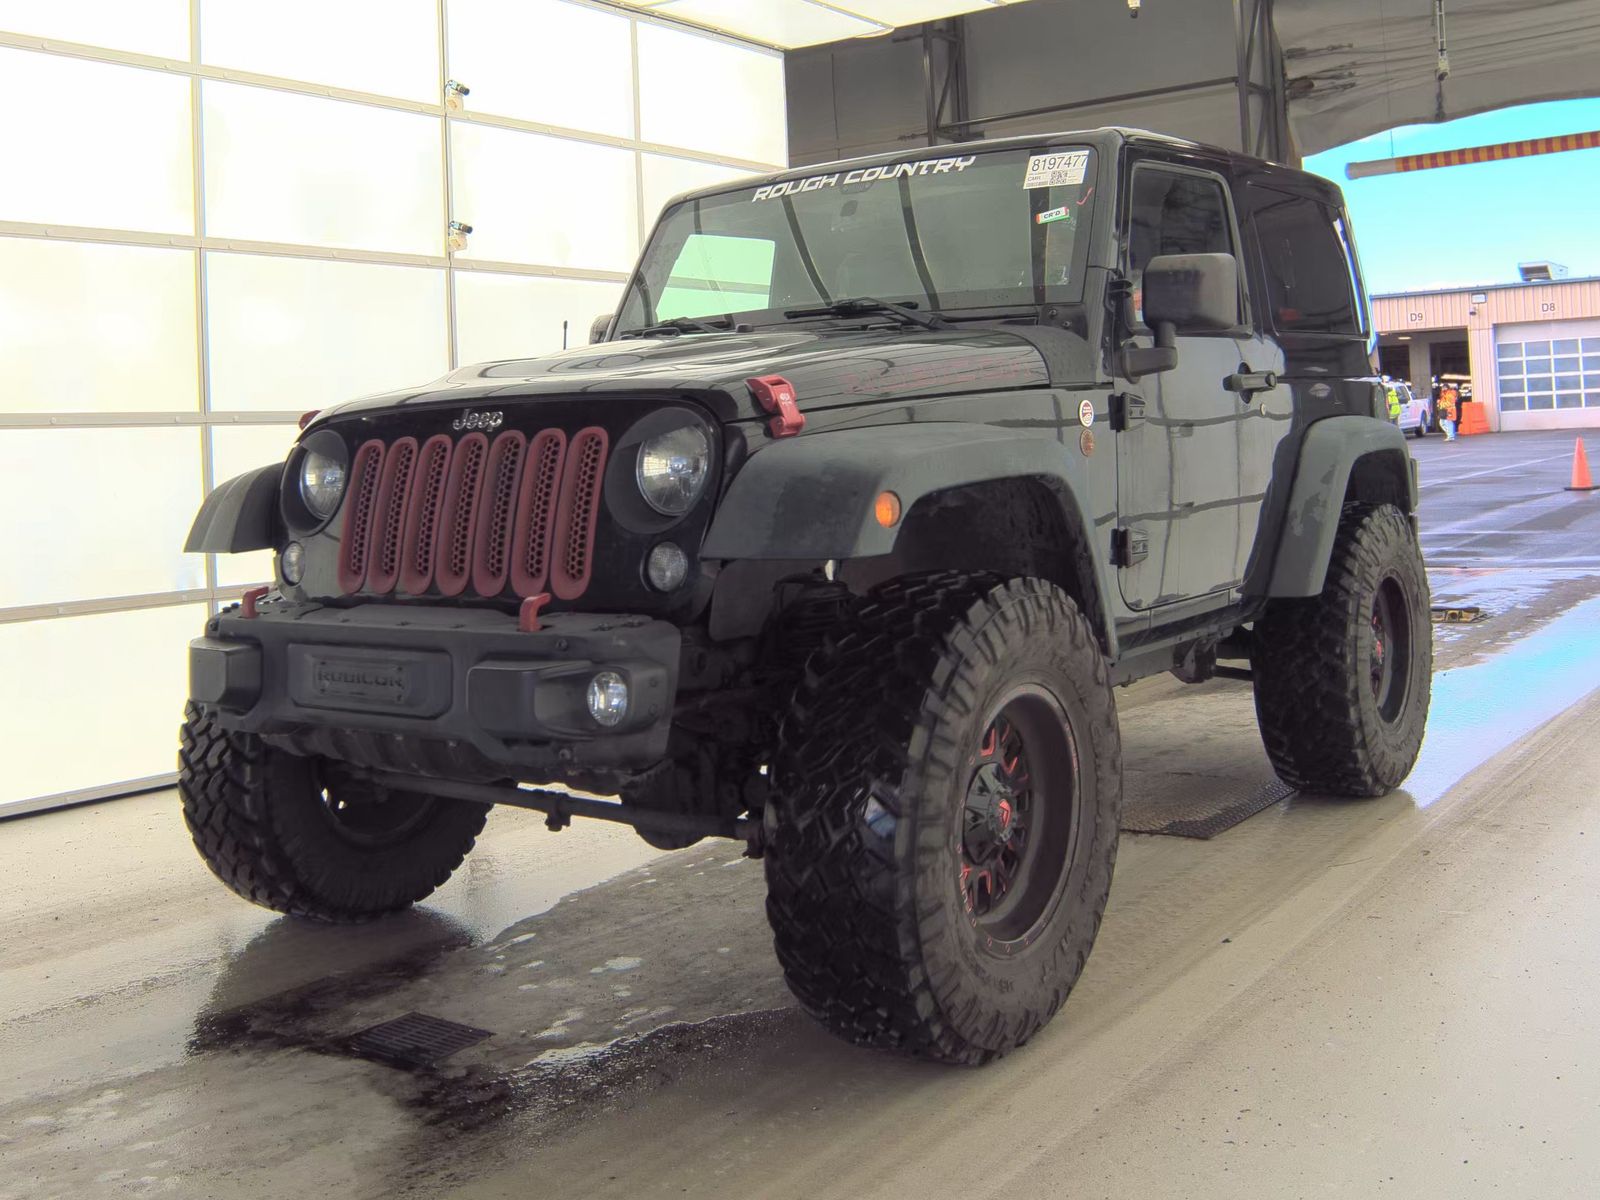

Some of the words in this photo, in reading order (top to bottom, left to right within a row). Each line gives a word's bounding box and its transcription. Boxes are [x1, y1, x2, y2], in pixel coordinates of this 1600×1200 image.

[1031, 154, 1088, 172] 8197477
[752, 174, 839, 202] ROUGH
[843, 156, 976, 185] COUNTRY
[1541, 302, 1556, 313] D8
[1409, 312, 1424, 322] D9
[452, 408, 504, 432] Jeep
